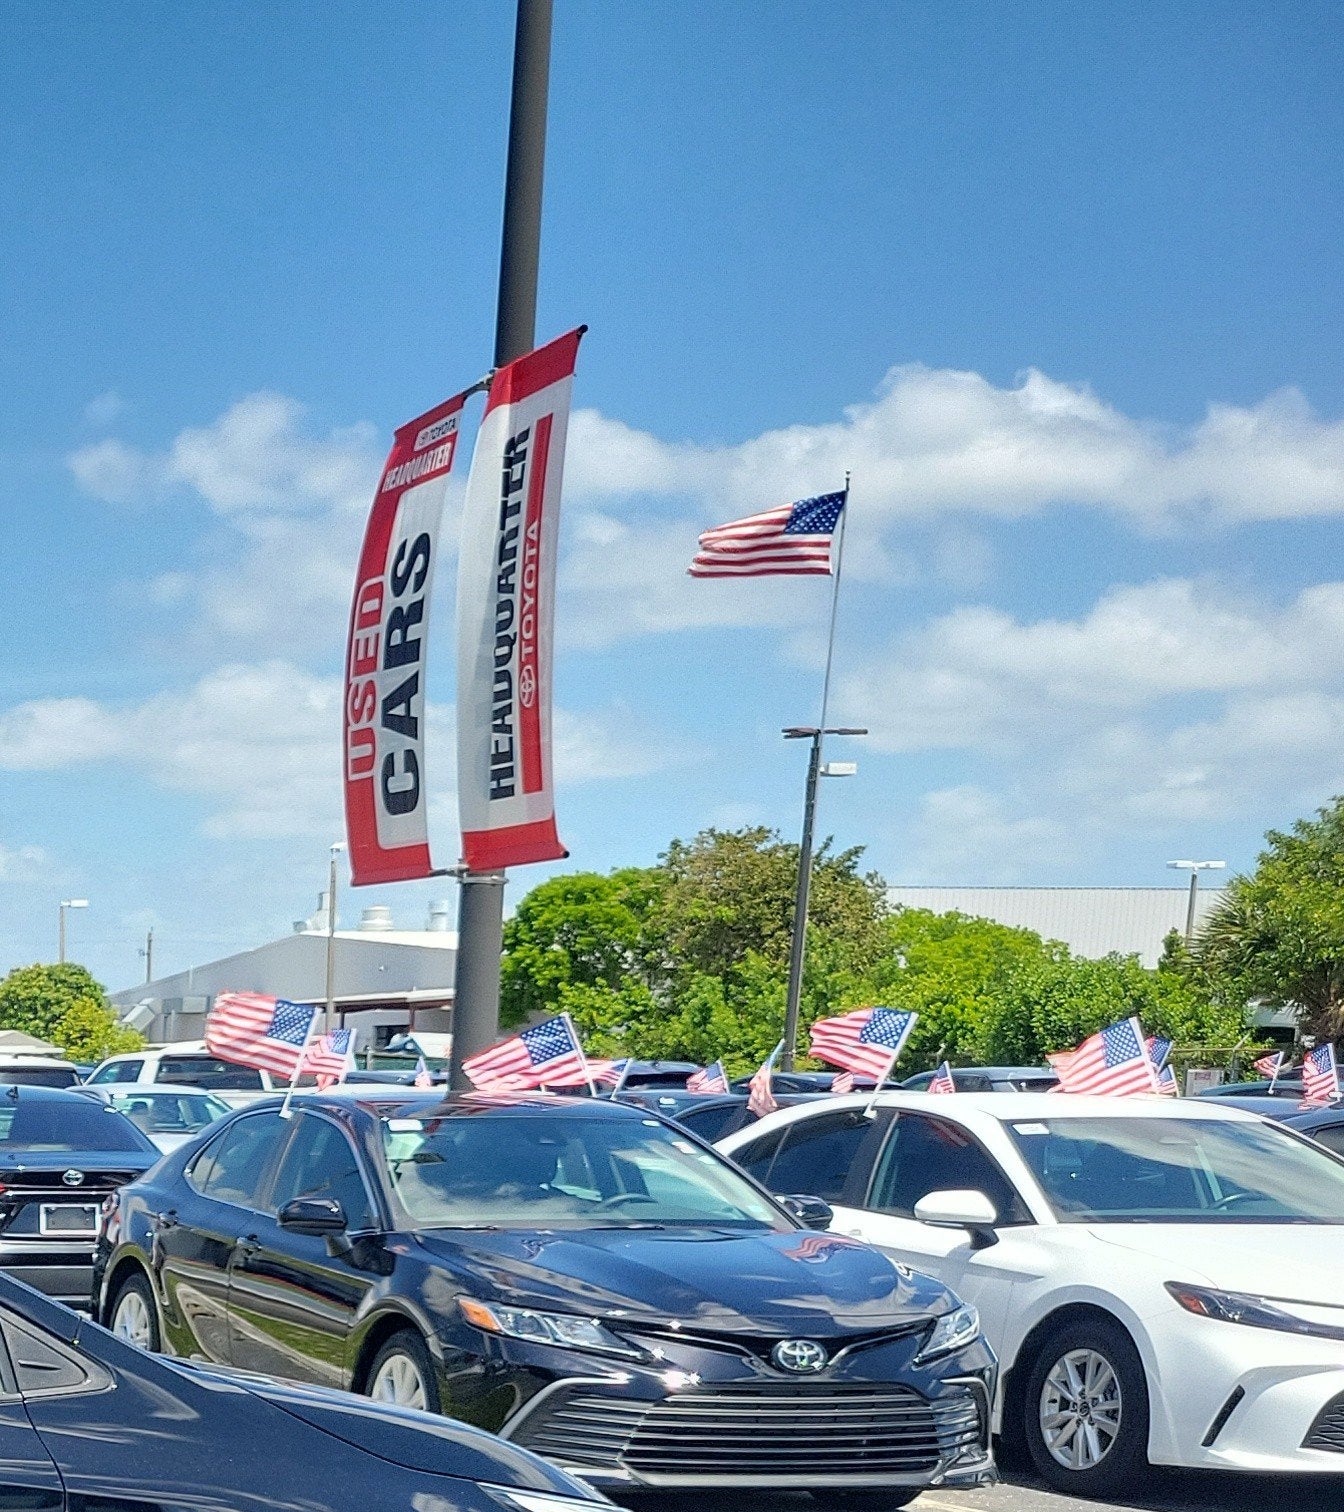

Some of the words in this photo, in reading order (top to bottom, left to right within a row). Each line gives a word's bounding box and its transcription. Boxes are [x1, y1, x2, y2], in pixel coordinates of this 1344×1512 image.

[382, 441, 452, 493] HEADQUARTER
[347, 575, 385, 781] USED
[380, 532, 430, 816] CARS
[489, 425, 531, 800] HEADQUARTER
[521, 520, 540, 661] TOYOTA
